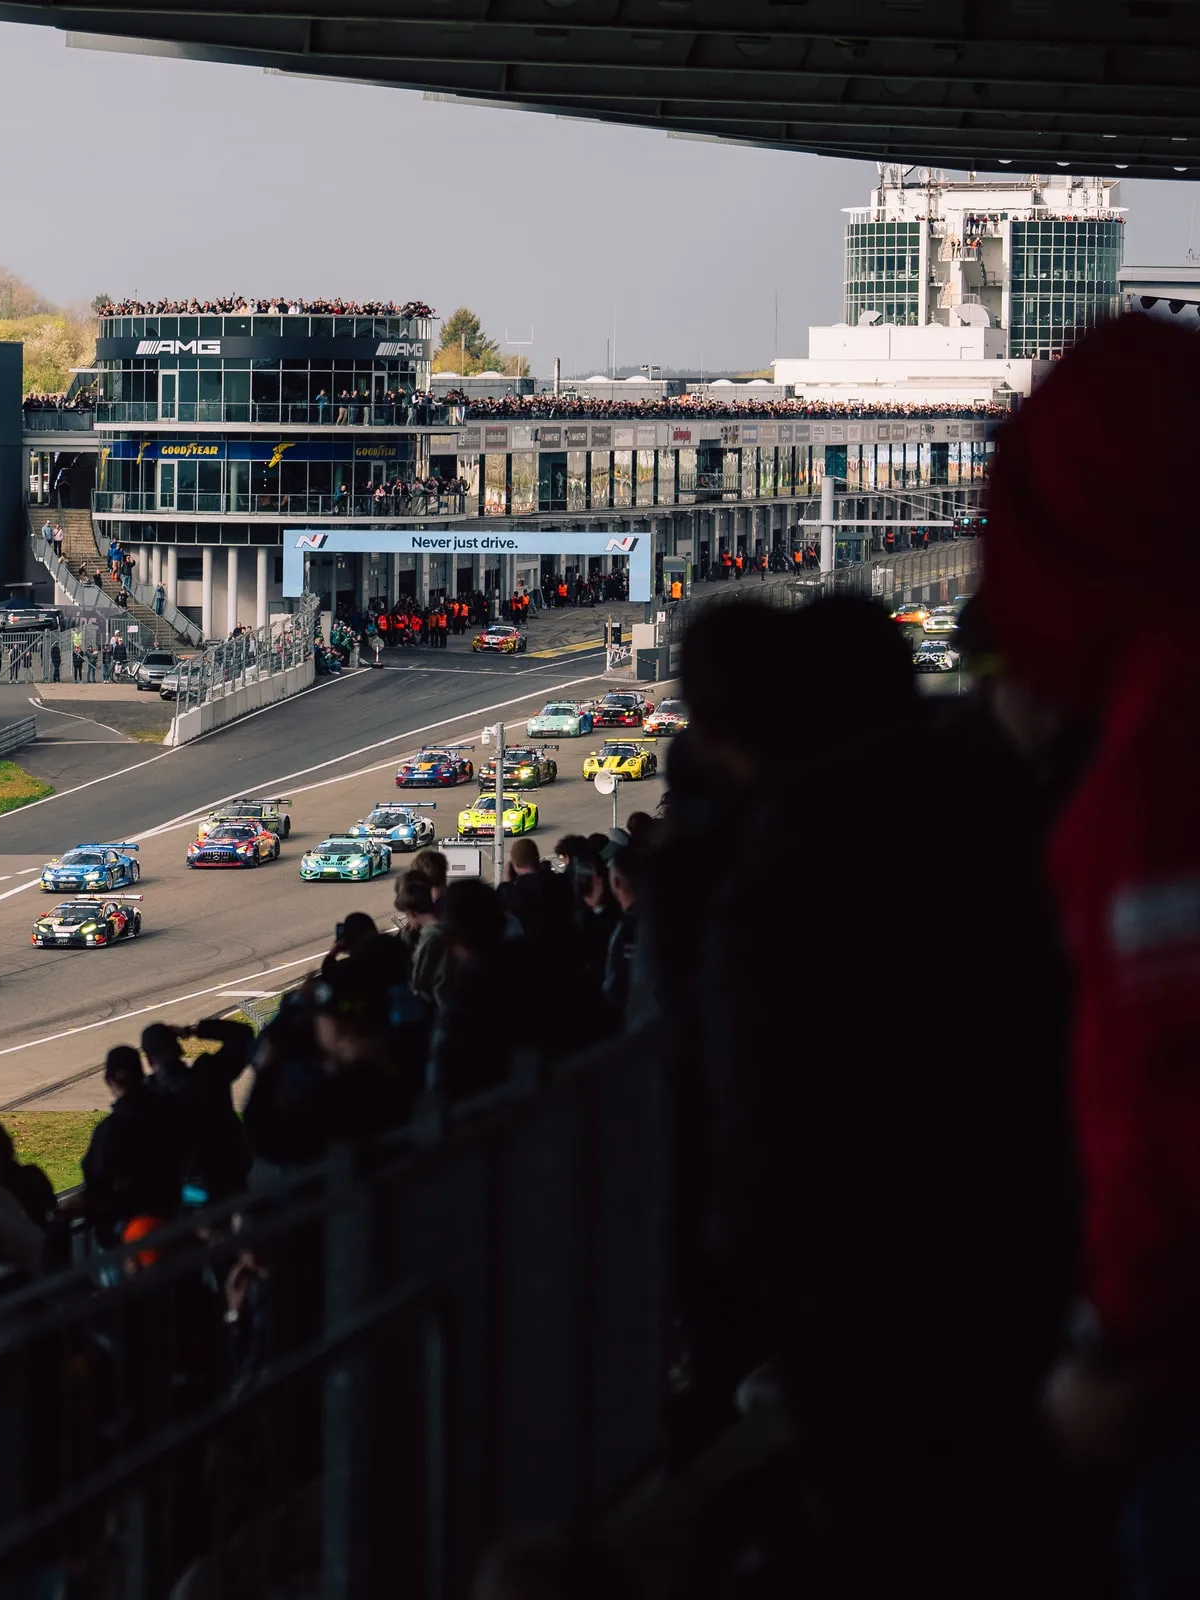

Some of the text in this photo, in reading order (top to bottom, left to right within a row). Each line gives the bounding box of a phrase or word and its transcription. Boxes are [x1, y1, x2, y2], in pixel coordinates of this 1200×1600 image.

[156, 340, 221, 355] AMG
[396, 342, 423, 357] AMG
[161, 443, 219, 457] GOODYEAR
[356, 446, 397, 457] GOODYEAR
[411, 536, 519, 551] Never just drive.
